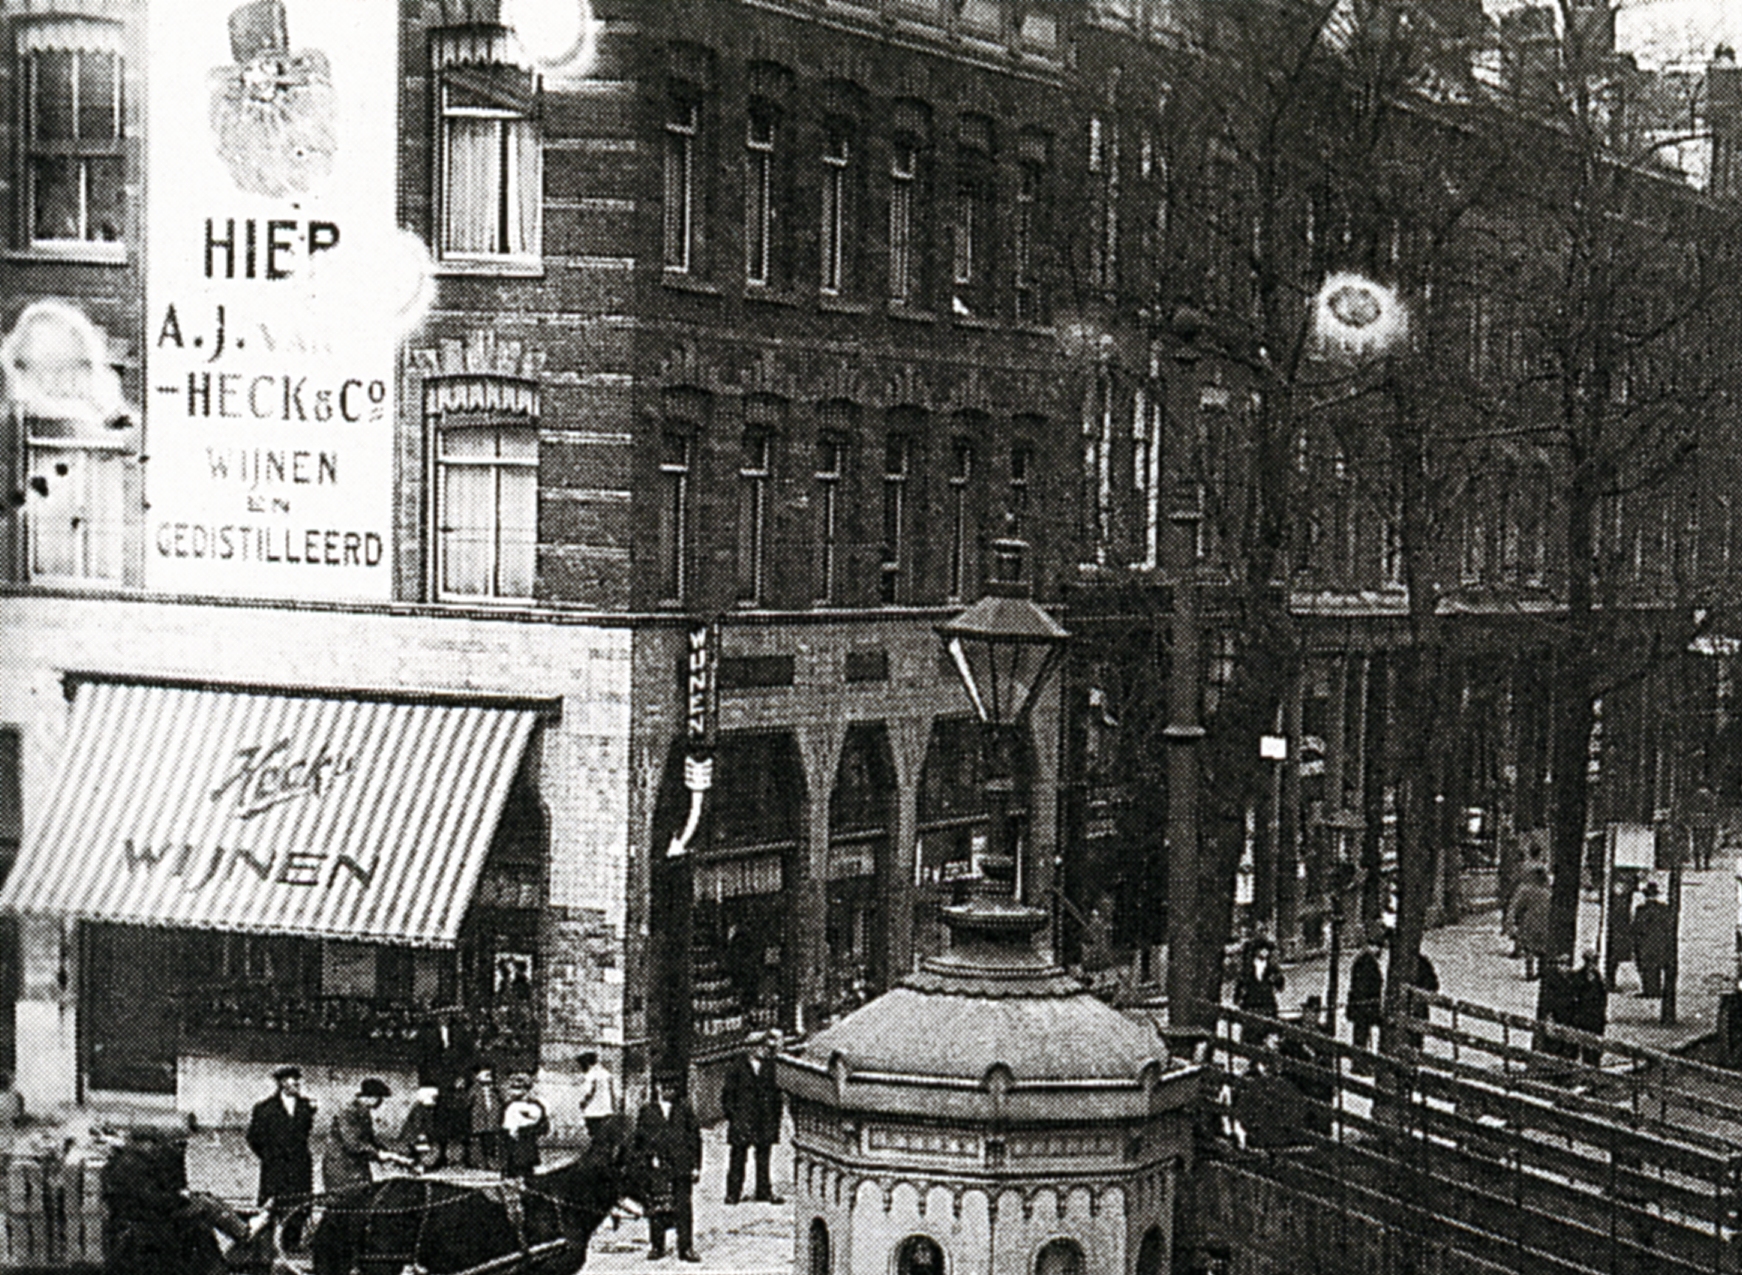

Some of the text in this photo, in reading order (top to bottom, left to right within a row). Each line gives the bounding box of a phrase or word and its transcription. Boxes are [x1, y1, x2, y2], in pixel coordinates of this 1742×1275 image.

[206, 446, 338, 489] WIJNEN
[156, 522, 383, 567] GEDISTILLEERD
[124, 838, 380, 893] WIJNEN
